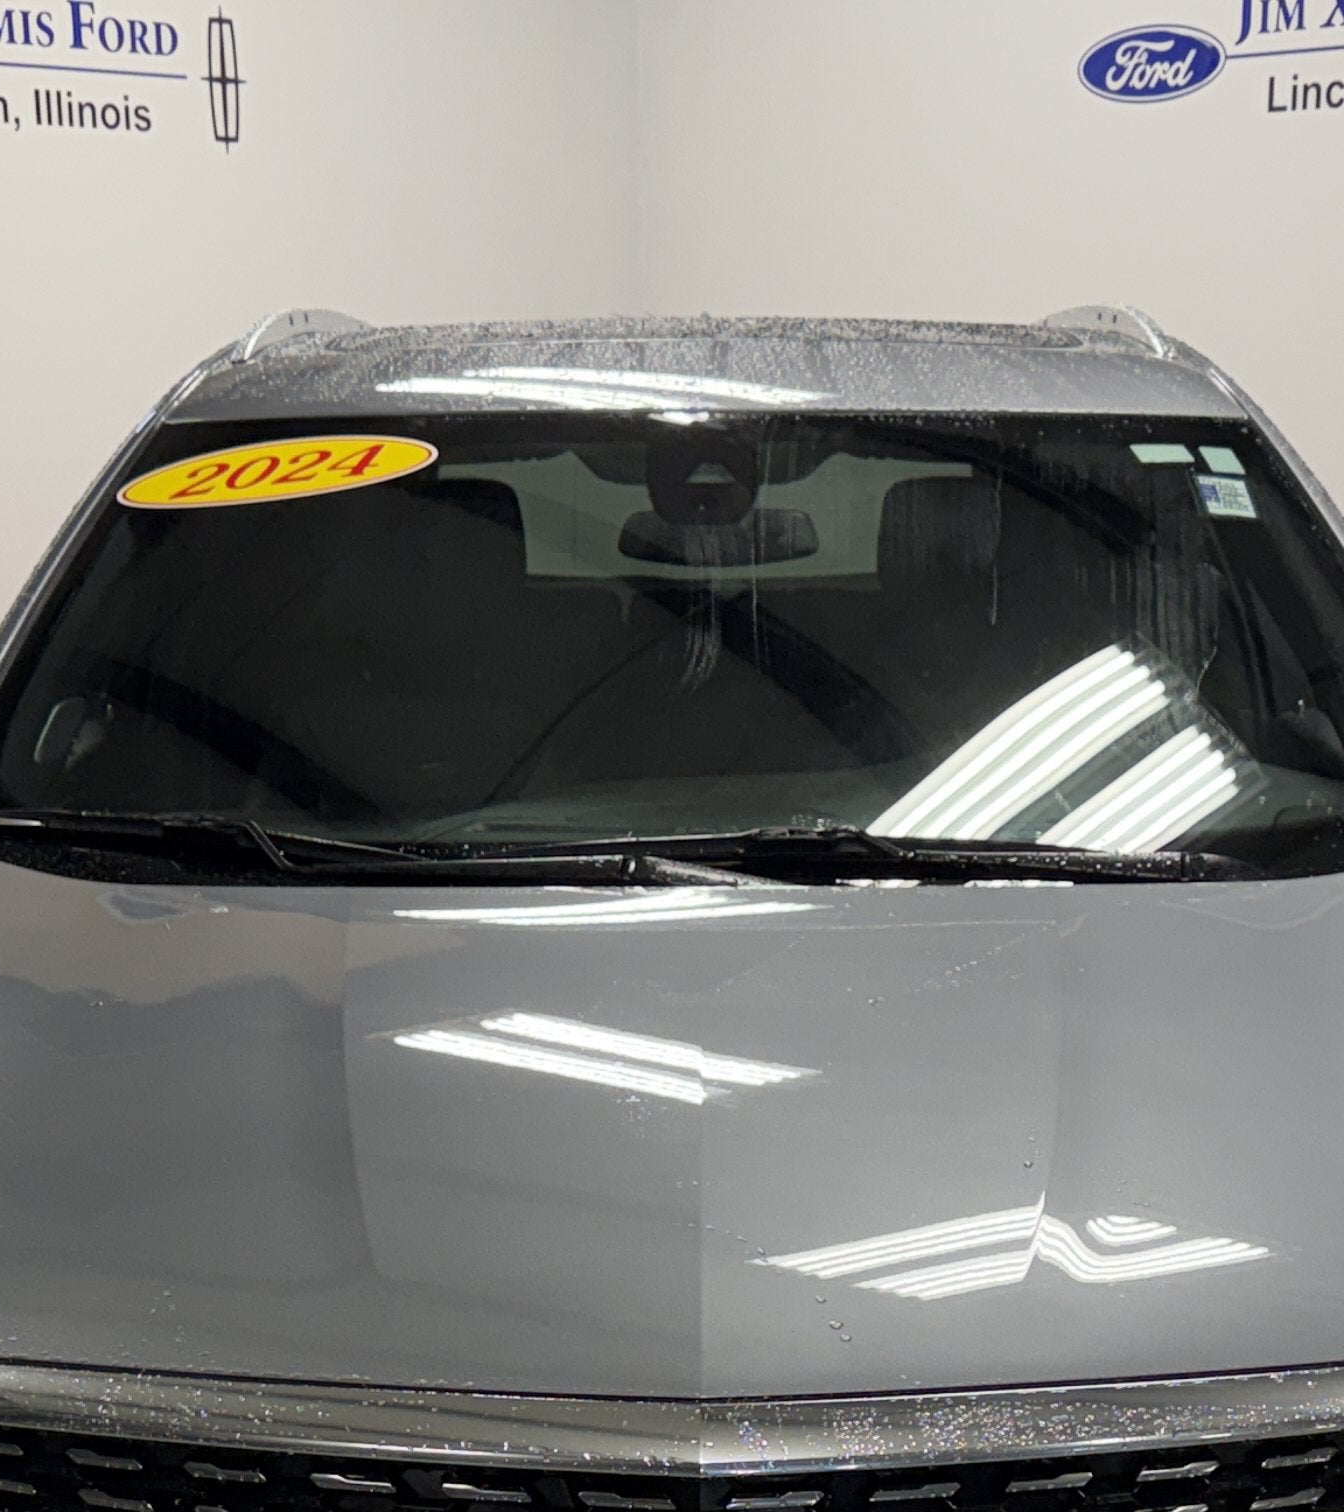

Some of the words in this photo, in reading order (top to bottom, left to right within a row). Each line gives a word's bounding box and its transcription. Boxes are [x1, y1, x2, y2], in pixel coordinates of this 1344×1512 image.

[66, 0, 179, 56] FORD
[1105, 40, 1194, 91] Ford
[34, 88, 153, 132] Illinois
[168, 444, 385, 500] 2024
